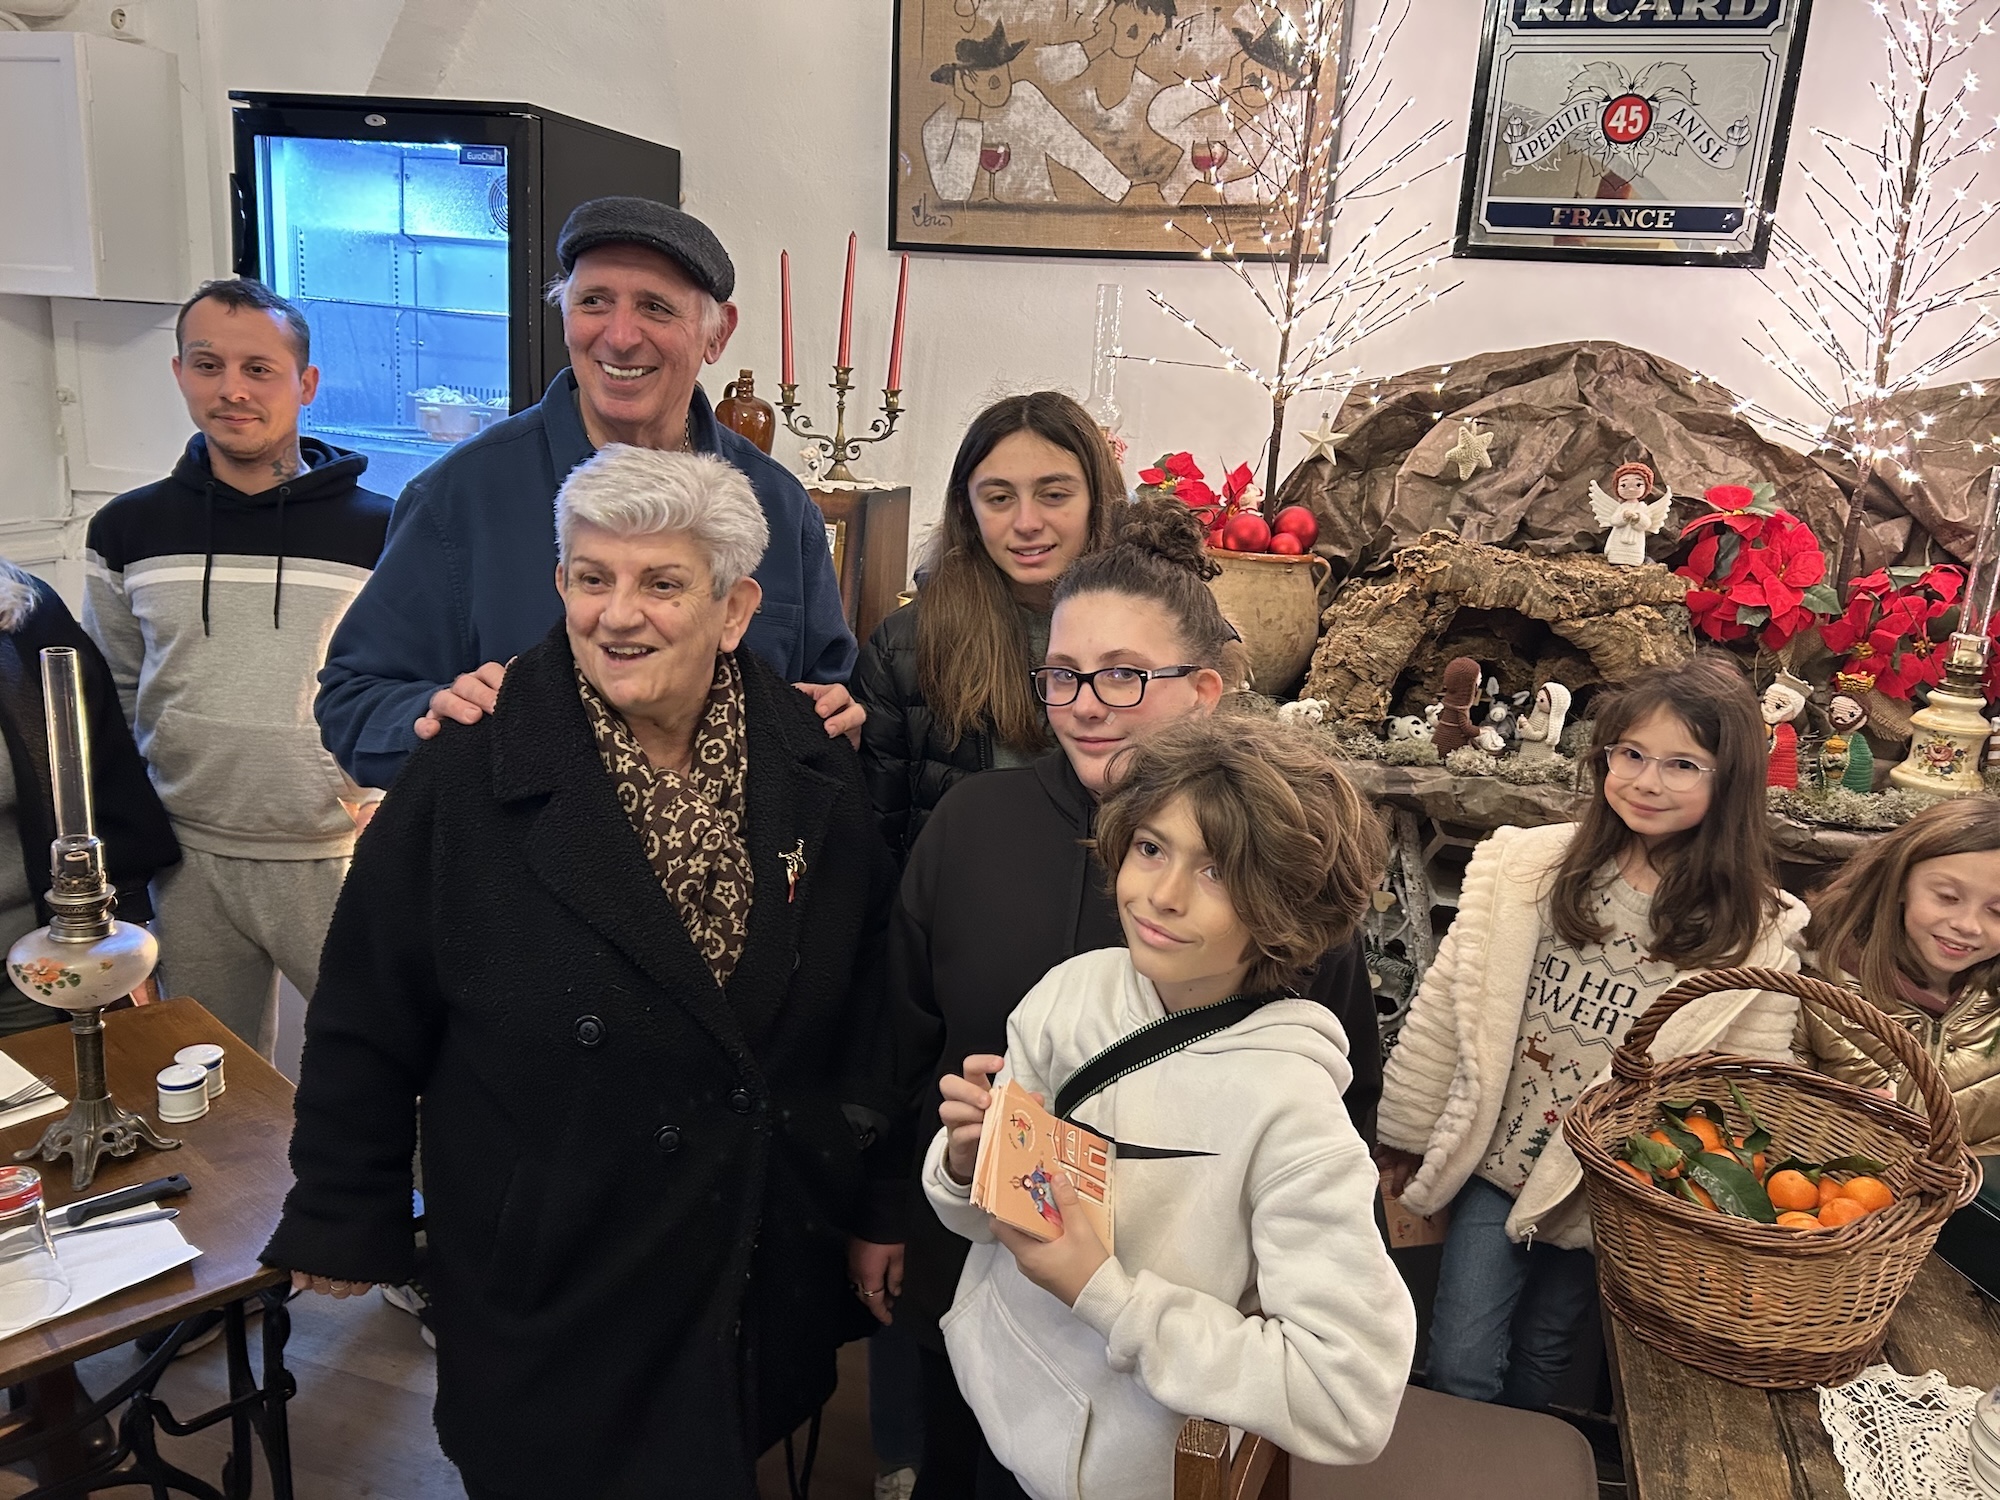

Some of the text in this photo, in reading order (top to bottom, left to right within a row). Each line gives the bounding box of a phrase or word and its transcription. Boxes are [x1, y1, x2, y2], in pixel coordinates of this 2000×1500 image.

[1521, 0, 1770, 22] RICARD
[1514, 102, 1590, 162] APÉRITIF
[1607, 105, 1643, 134] 45
[1667, 107, 1728, 163] ANISÉ
[1550, 207, 1676, 229] FRANCE
[1579, 971, 1637, 1009] HO
